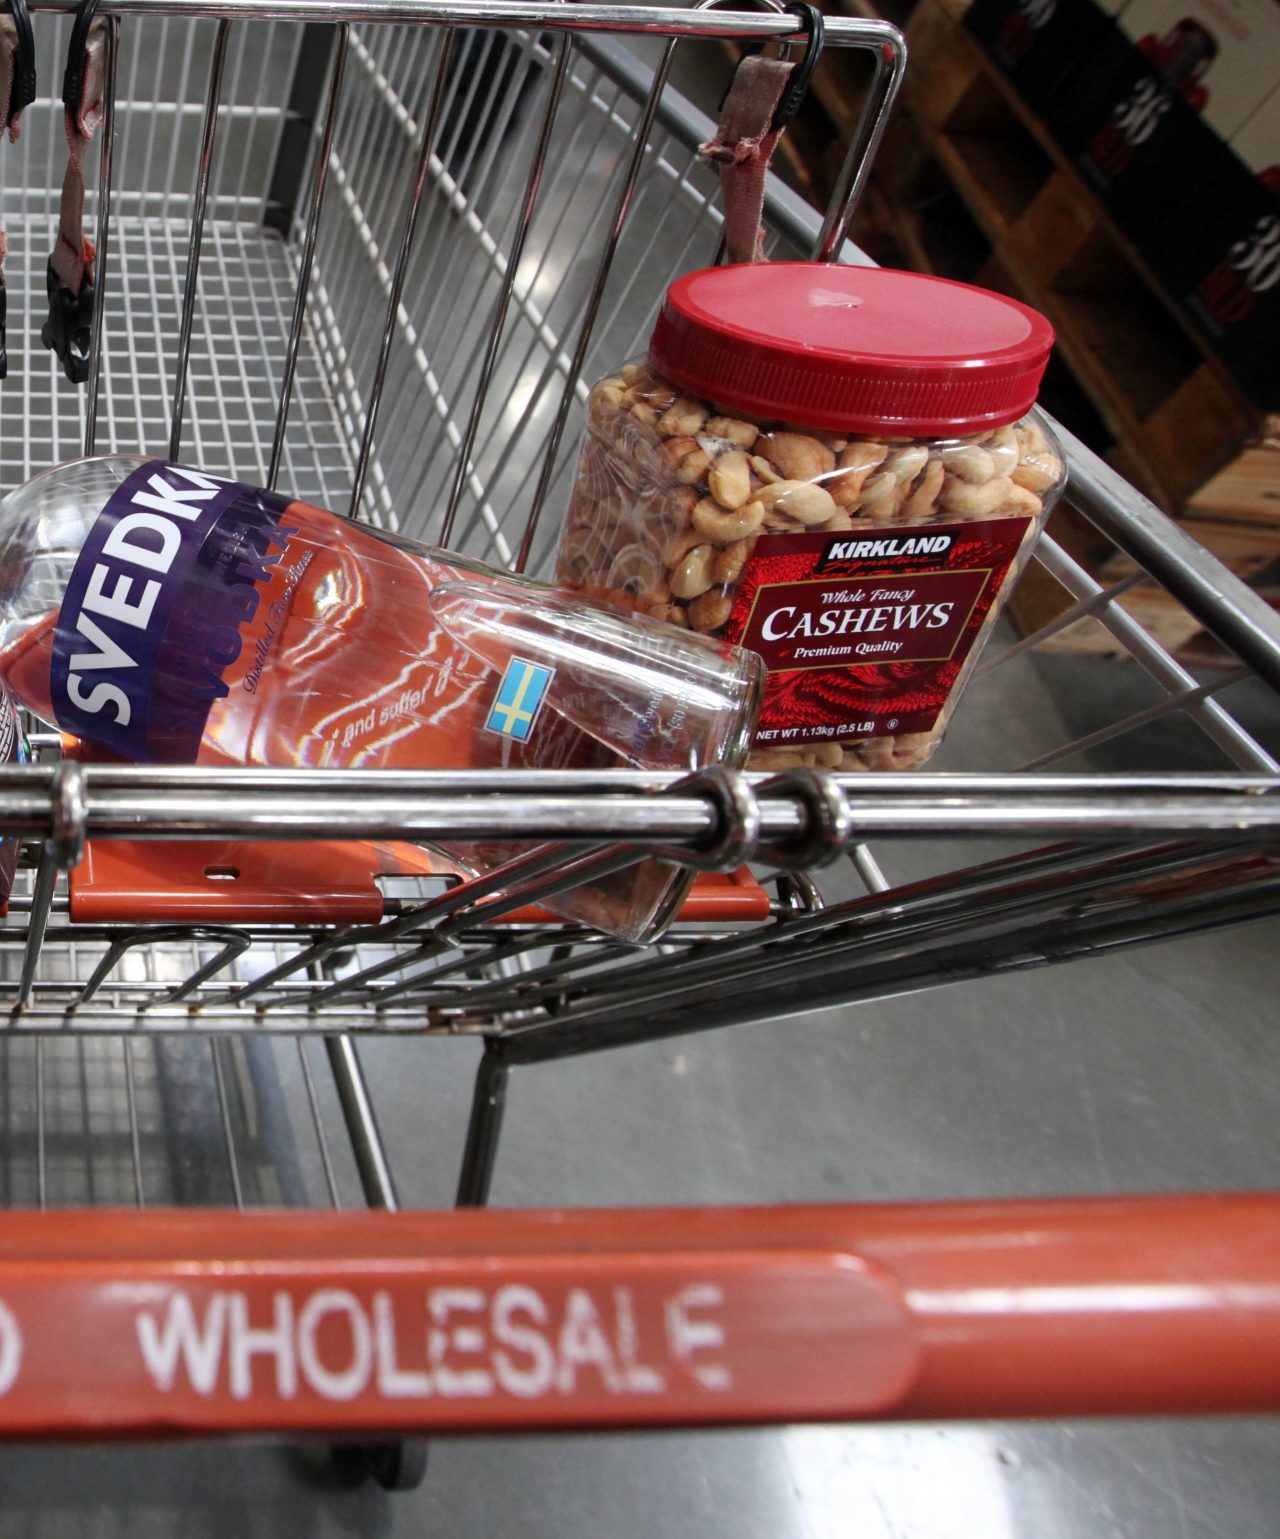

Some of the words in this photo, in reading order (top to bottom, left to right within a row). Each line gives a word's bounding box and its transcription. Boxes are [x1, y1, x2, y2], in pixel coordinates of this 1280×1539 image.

[827, 536, 951, 560] KIRKLAND
[194, 525, 302, 699] VODKA
[821, 589, 866, 604] Whole
[870, 588, 916, 602] Fancy
[761, 602, 954, 642] CASHEWS
[243, 624, 278, 694] Distilled
[793, 643, 852, 659] Premium
[855, 639, 903, 654] Quality
[756, 729, 779, 741] NET
[781, 728, 800, 739] WT
[801, 725, 835, 738] 1.13kg
[836, 723, 855, 737] (2.5
[856, 721, 875, 734] LB)
[135, 1284, 733, 1401] WHOLESALE
